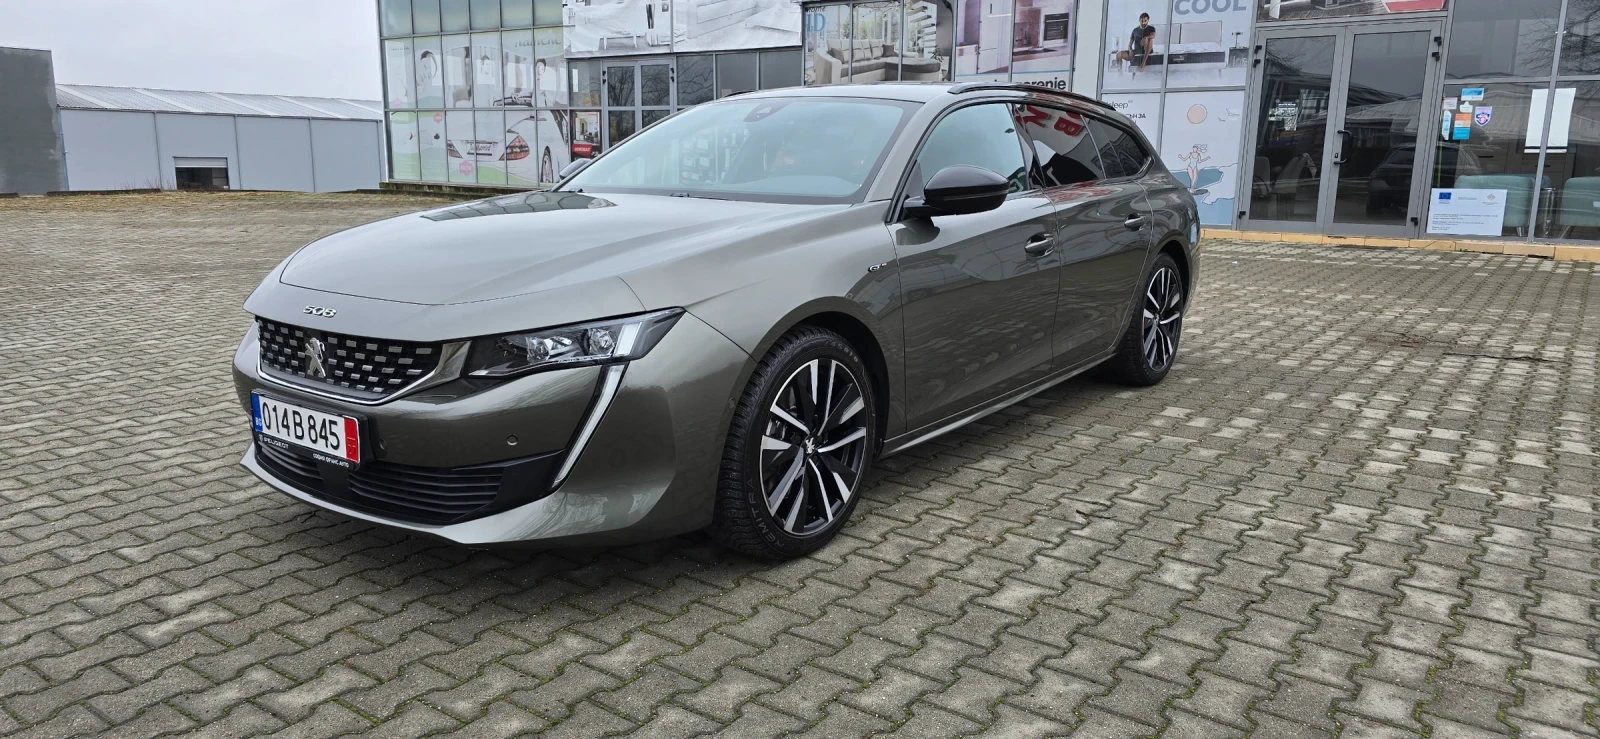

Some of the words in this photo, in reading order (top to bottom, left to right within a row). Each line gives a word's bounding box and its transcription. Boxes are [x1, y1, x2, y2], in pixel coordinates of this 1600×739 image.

[1174, 0, 1246, 15] COOL
[303, 305, 337, 317] 508
[263, 437, 289, 449] PEUGEOT
